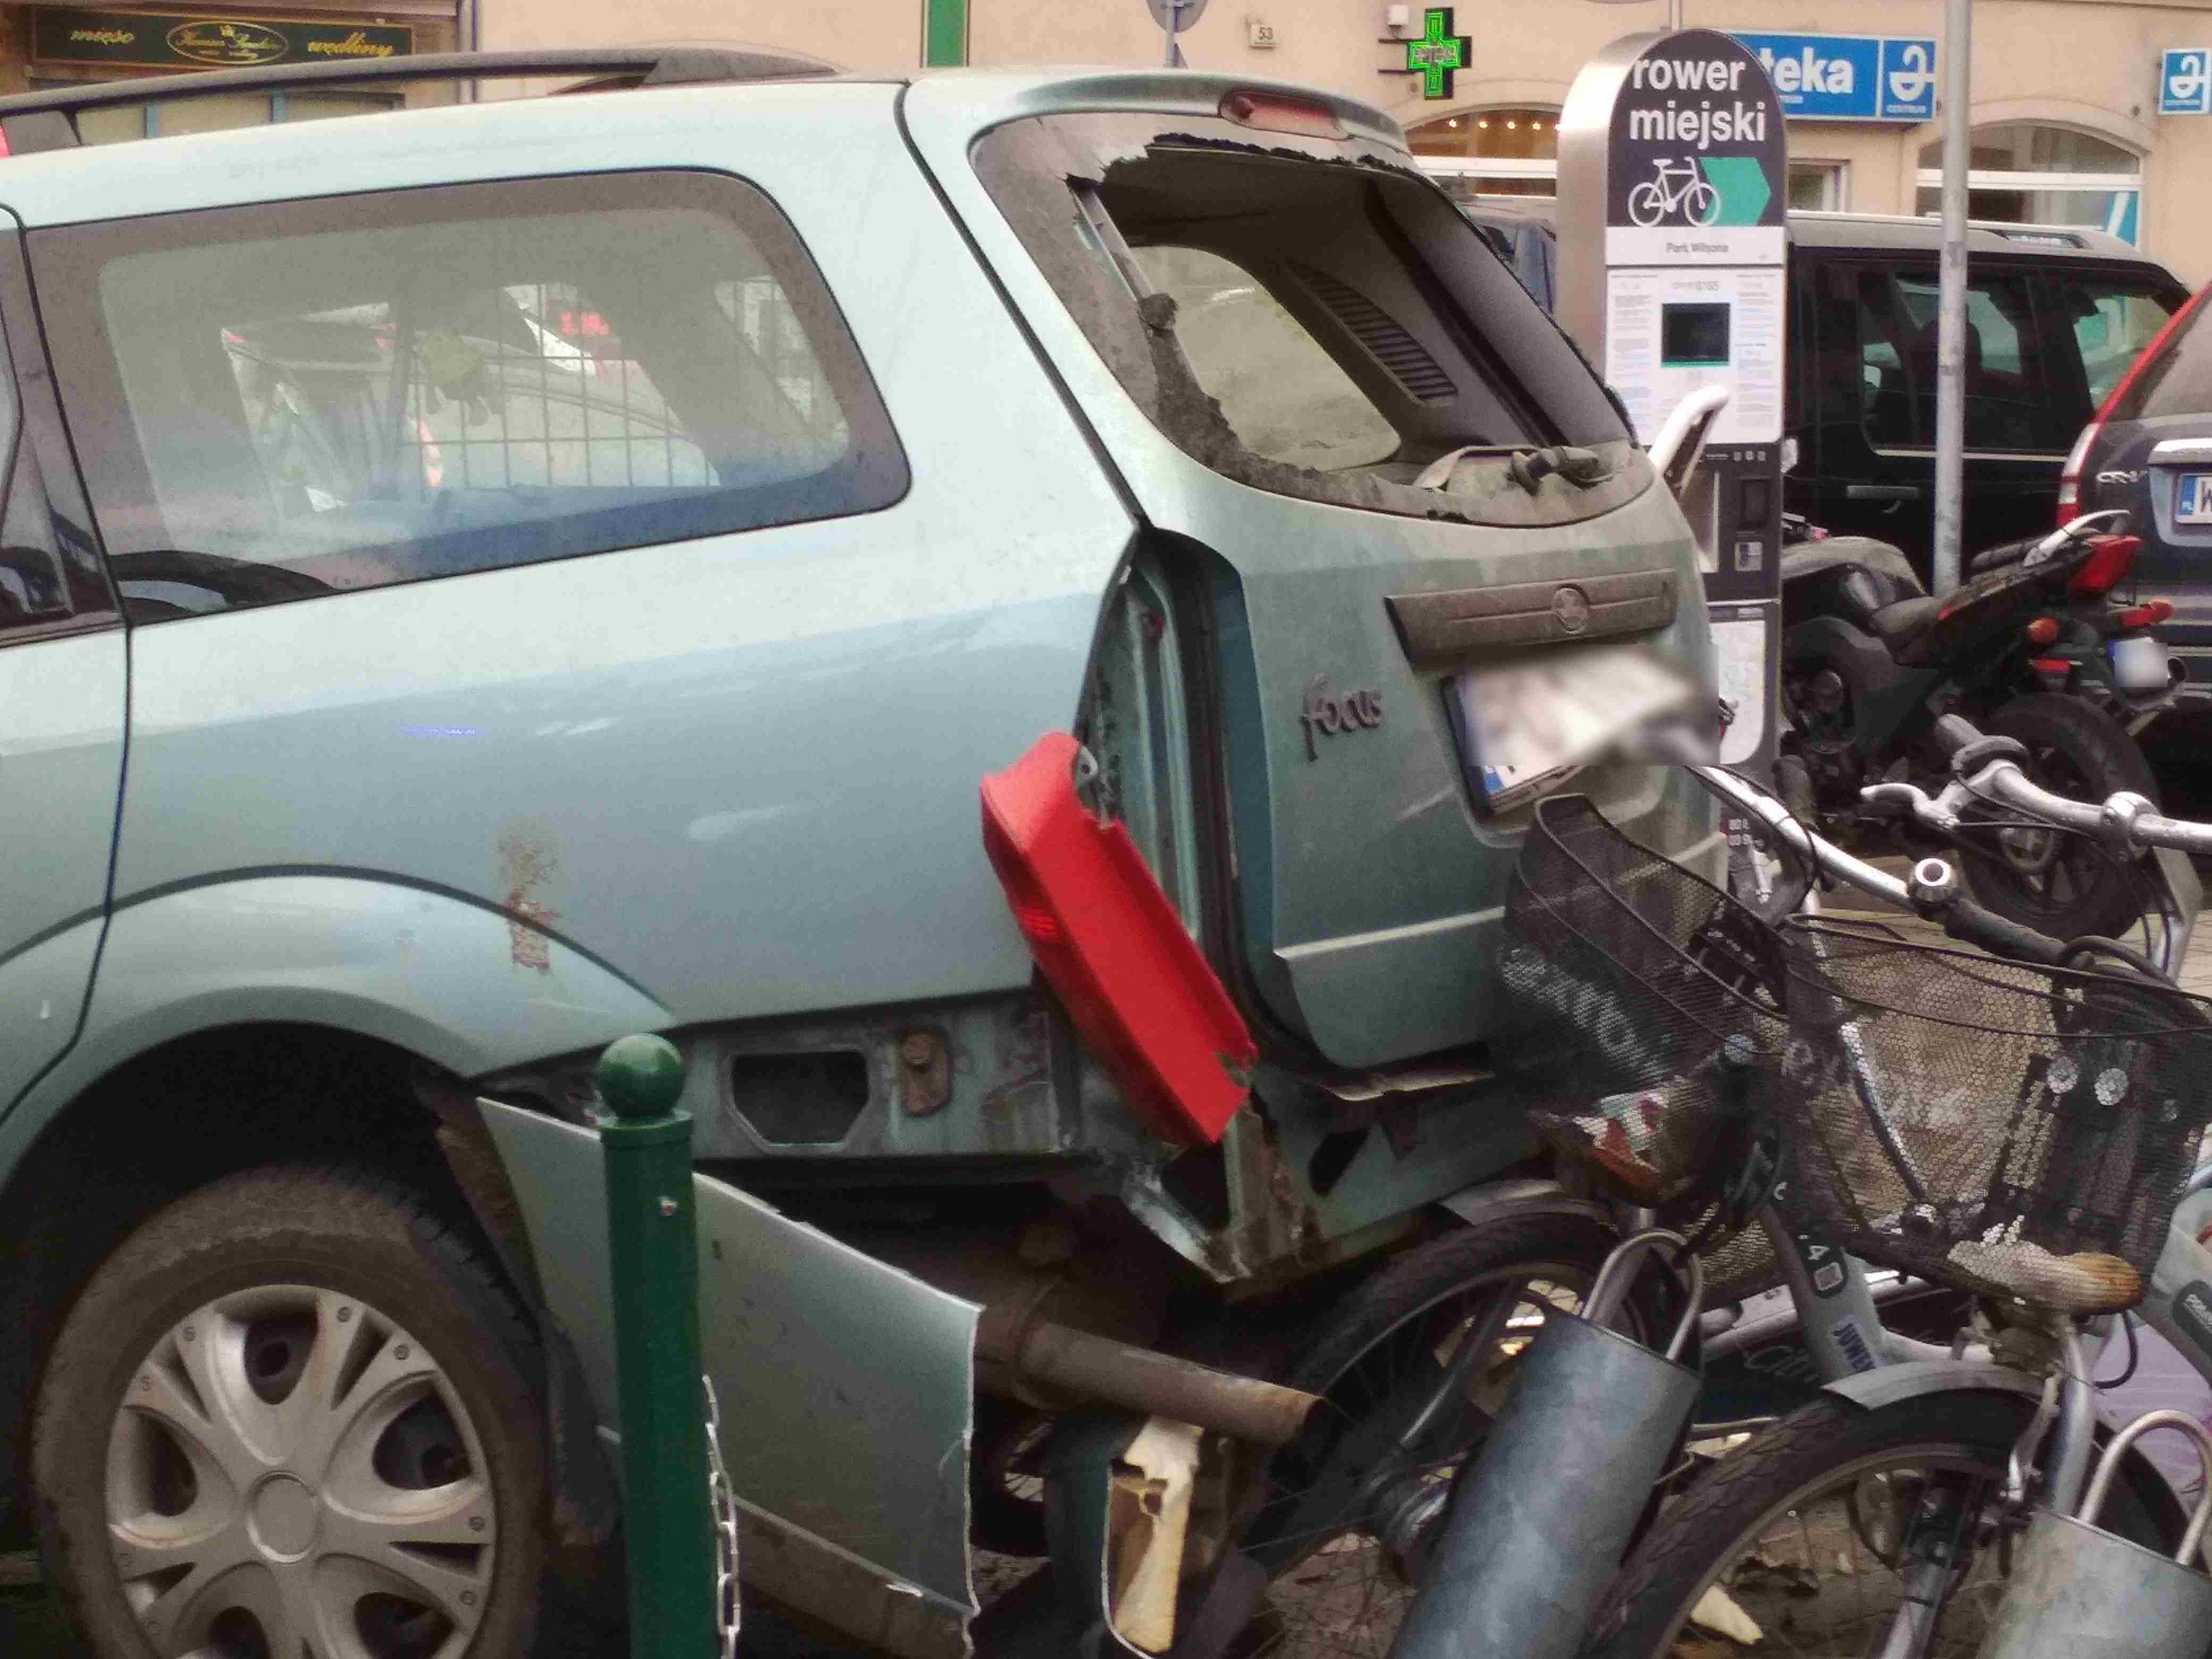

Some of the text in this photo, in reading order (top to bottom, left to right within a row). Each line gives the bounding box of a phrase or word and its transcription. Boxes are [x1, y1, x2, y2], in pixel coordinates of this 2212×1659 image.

[1259, 27, 1272, 40] 53
[1632, 58, 1747, 91] rower
[1629, 100, 1766, 150] miejski
